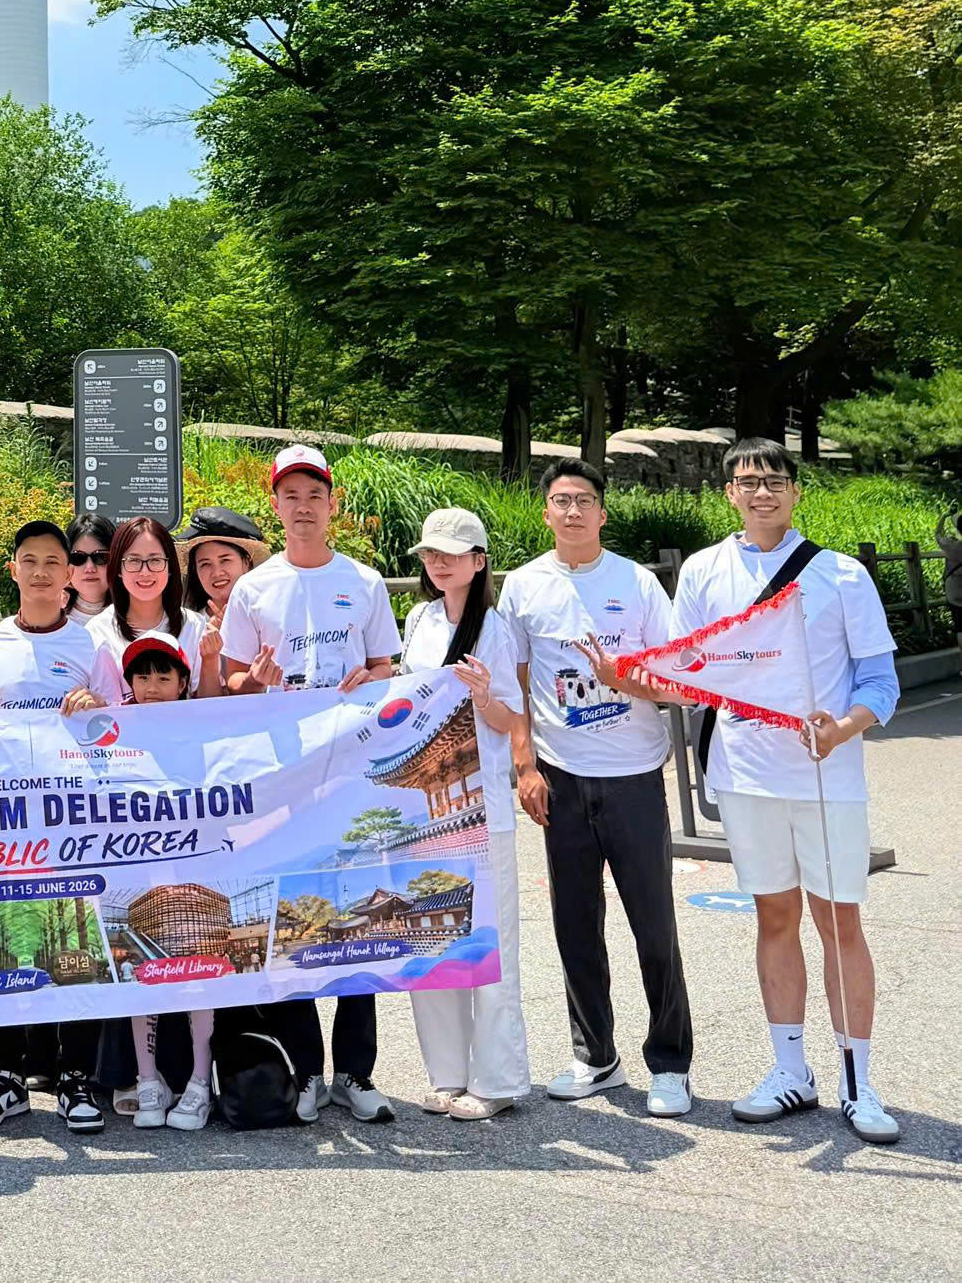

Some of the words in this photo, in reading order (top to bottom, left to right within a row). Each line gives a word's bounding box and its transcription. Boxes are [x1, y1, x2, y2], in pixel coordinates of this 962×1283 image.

[289, 629, 349, 653] TECHMICOM
[708, 649, 782, 661] HanoiSkytours
[579, 705, 618, 722] TOGETHER
[59, 748, 144, 760] HanoiSkytours
[55, 776, 83, 789] THE
[43, 783, 254, 827] DELEGATION
[59, 833, 99, 862] OF
[101, 828, 199, 860] KOREA
[1, 884, 32, 896] 11-15
[35, 882, 66, 894] JUNE
[68, 880, 97, 892] 2026
[347, 946, 372, 958] Hanok
[374, 943, 401, 957] Village
[58, 956, 90, 970] 남이섬
[144, 961, 185, 978] Starfield
[188, 961, 224, 976] Library
[5, 972, 38, 989] Island
